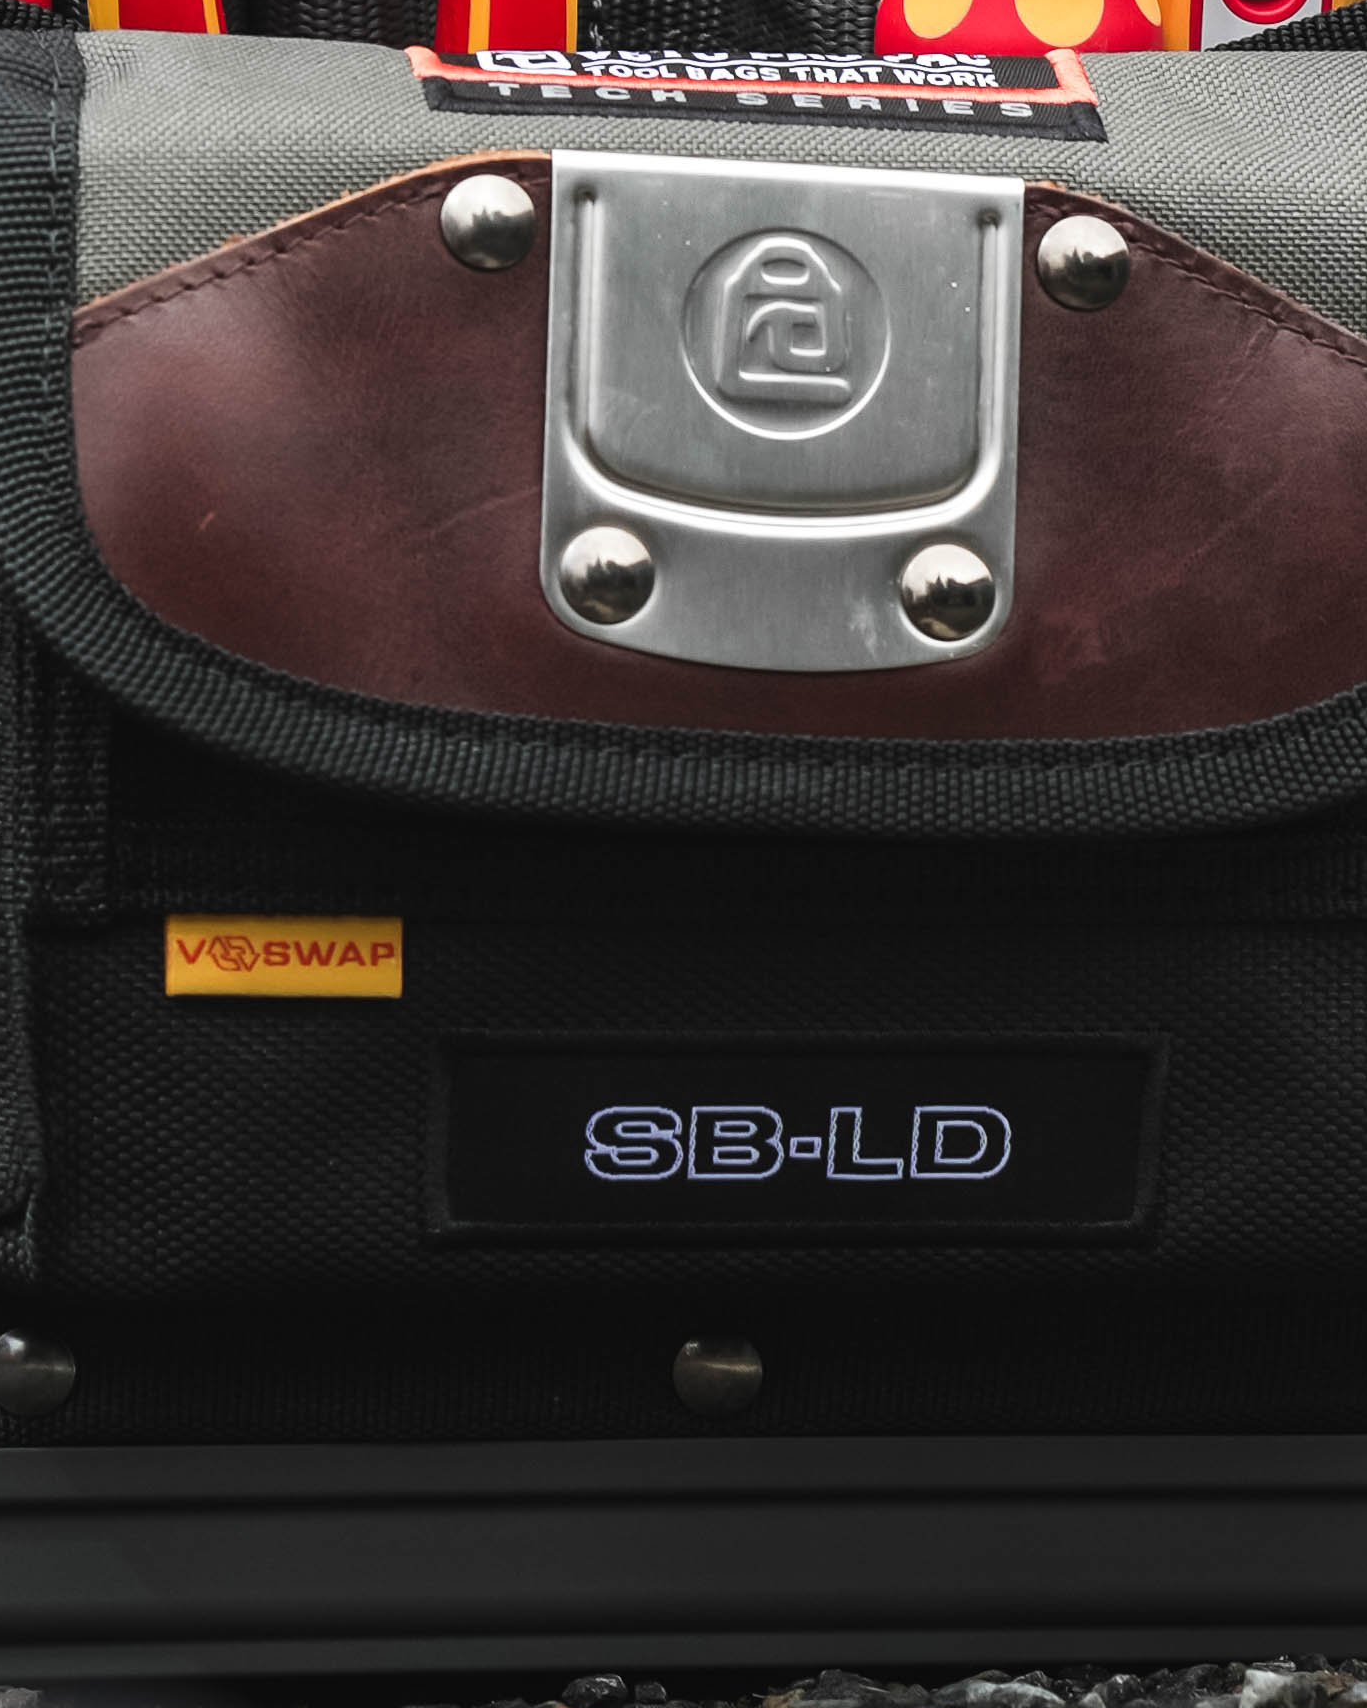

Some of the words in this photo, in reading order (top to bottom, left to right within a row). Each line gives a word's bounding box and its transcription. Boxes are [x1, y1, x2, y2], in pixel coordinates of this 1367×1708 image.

[583, 65, 678, 80] TOOL
[685, 65, 781, 82] BAGS
[789, 66, 883, 84] THAT
[892, 71, 999, 89] WORK
[488, 81, 687, 103] TECH
[736, 92, 1033, 118] SERIES
